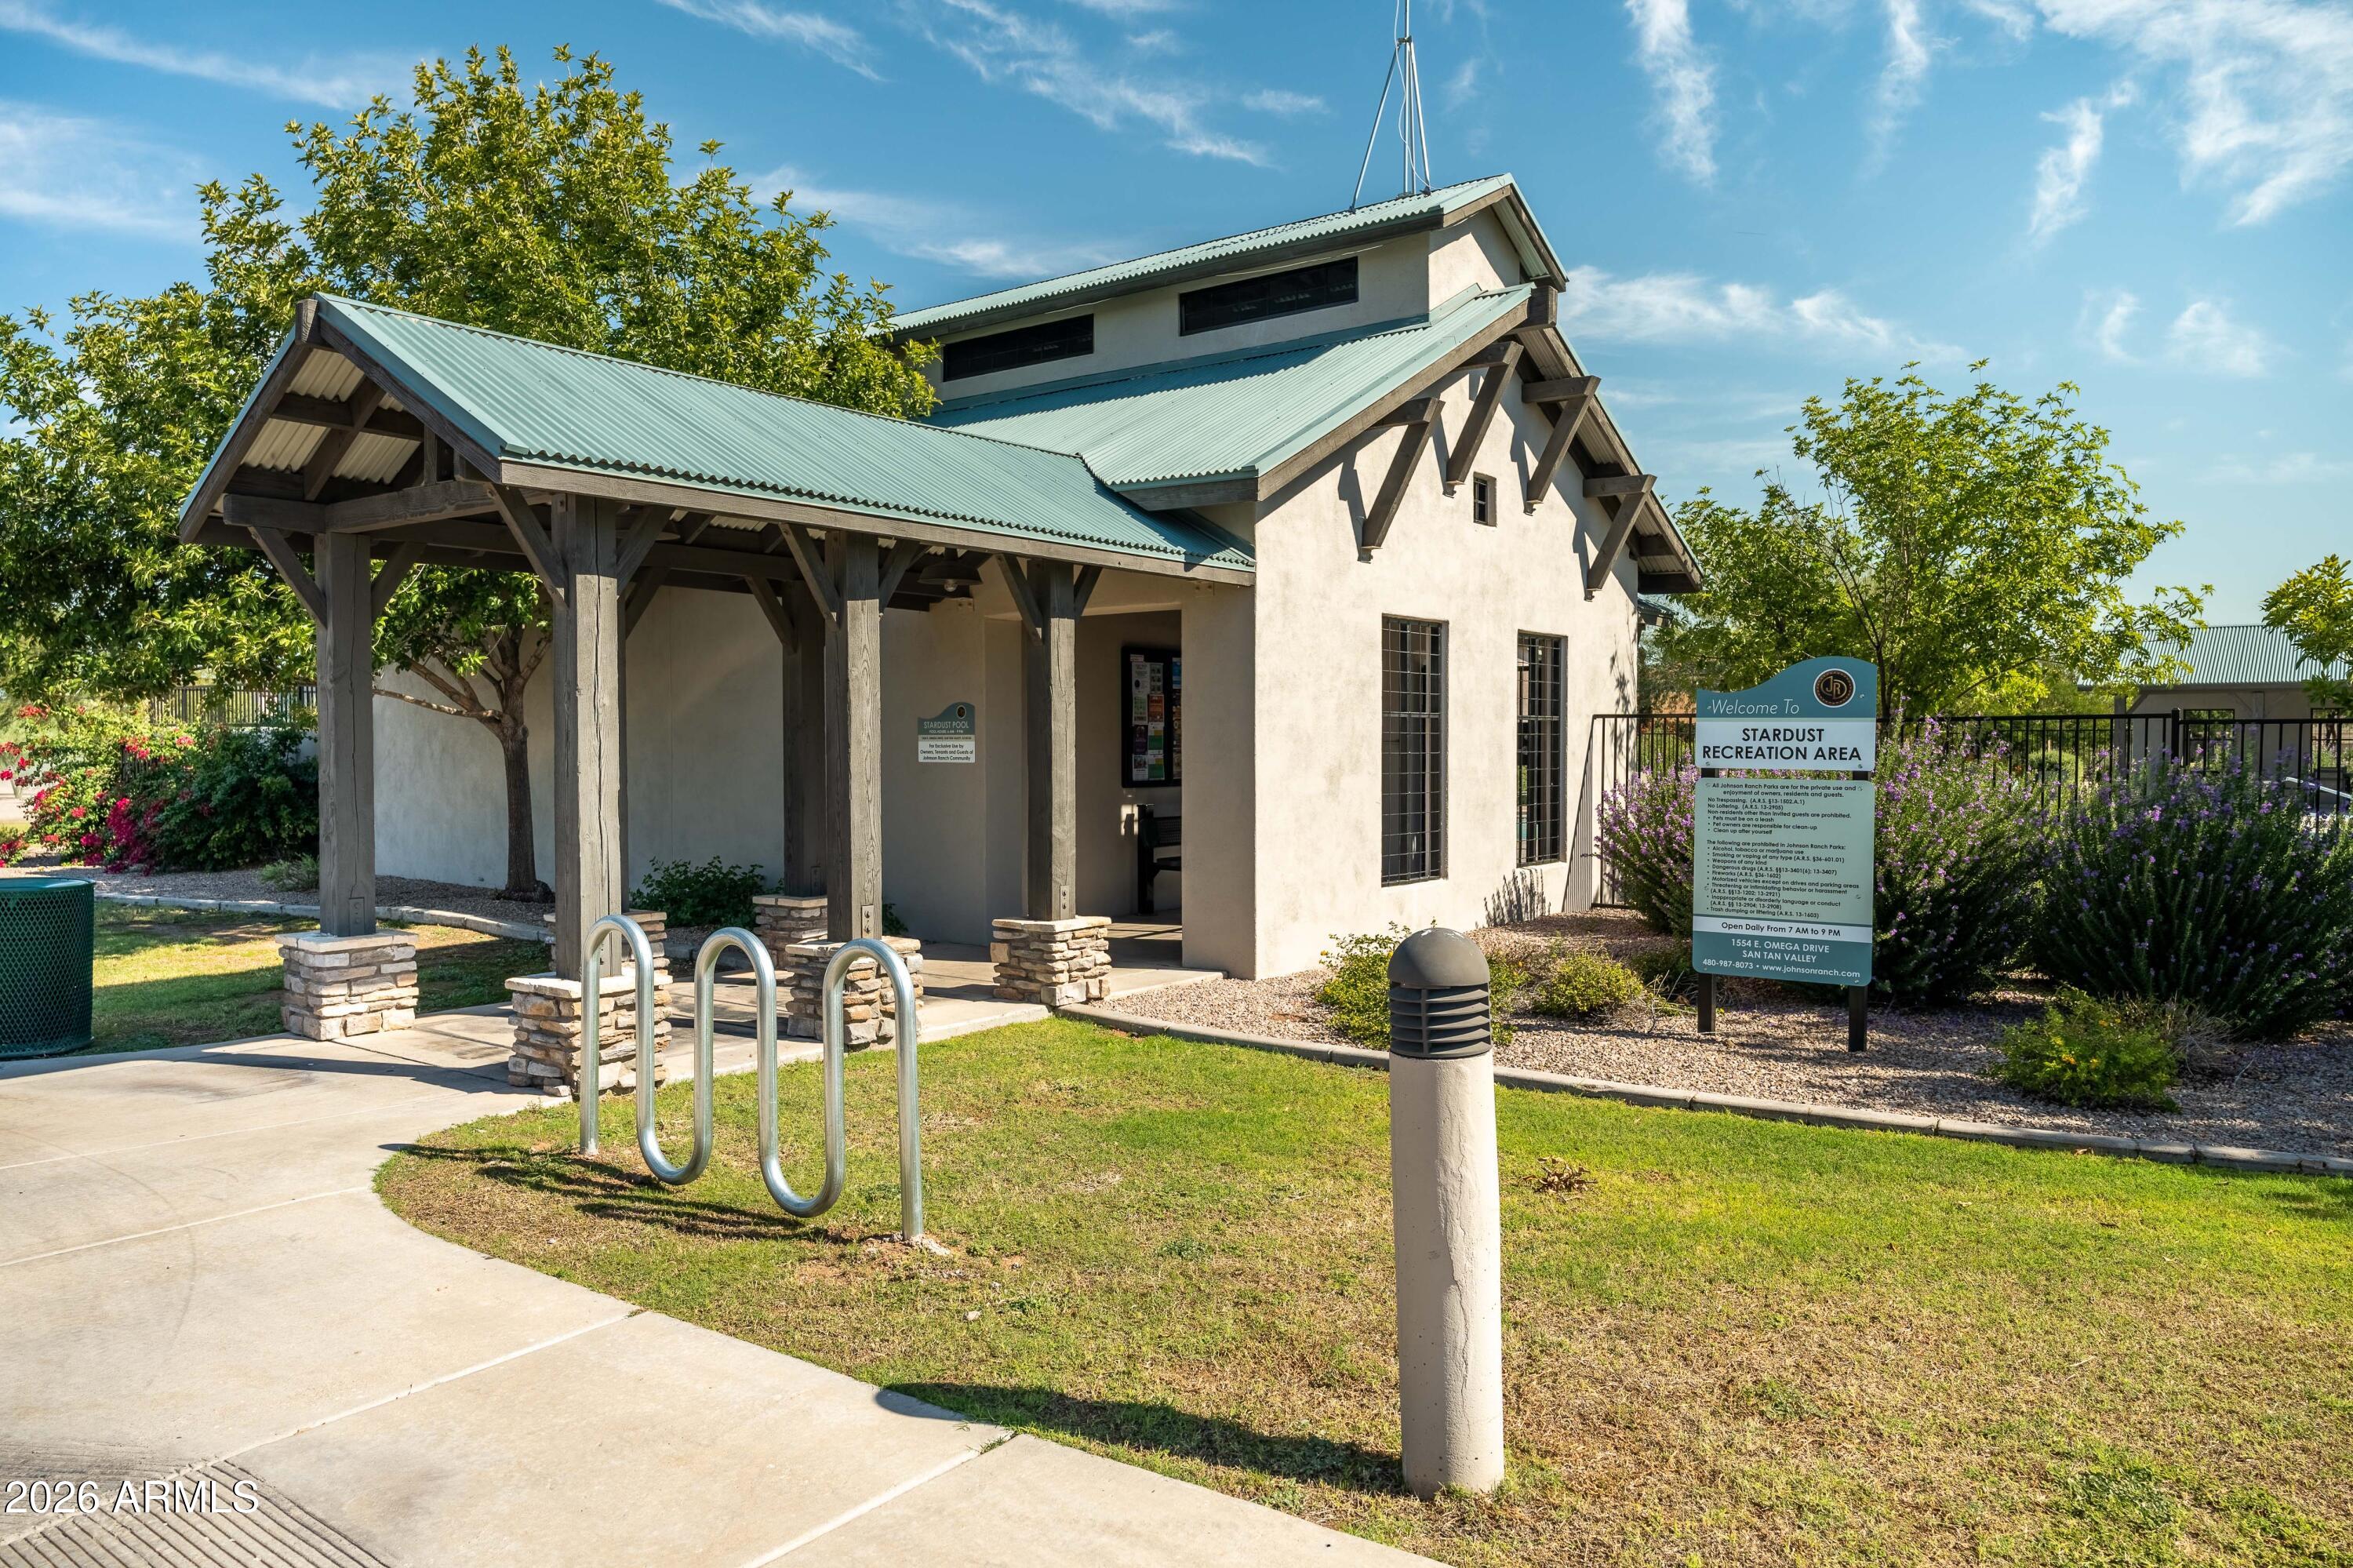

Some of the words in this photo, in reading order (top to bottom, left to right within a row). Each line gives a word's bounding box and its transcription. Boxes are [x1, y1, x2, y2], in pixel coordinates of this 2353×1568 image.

[1712, 700, 1778, 715] Welcome
[1784, 699, 1799, 715] To
[1742, 728, 1824, 742] STARDUST
[1703, 746, 1807, 760] RECREATION
[1814, 747, 1861, 761] AREA
[1732, 939, 1751, 948] 1554
[1765, 941, 1800, 951] OMEGA
[1803, 944, 1829, 952] DRIVE
[1743, 950, 1761, 959] SAN
[1763, 951, 1780, 960] TAN
[1784, 954, 1817, 962] VALLEY
[1703, 959, 1754, 970] 480-987-8073
[1762, 964, 1860, 977] www.johnsonranch.com
